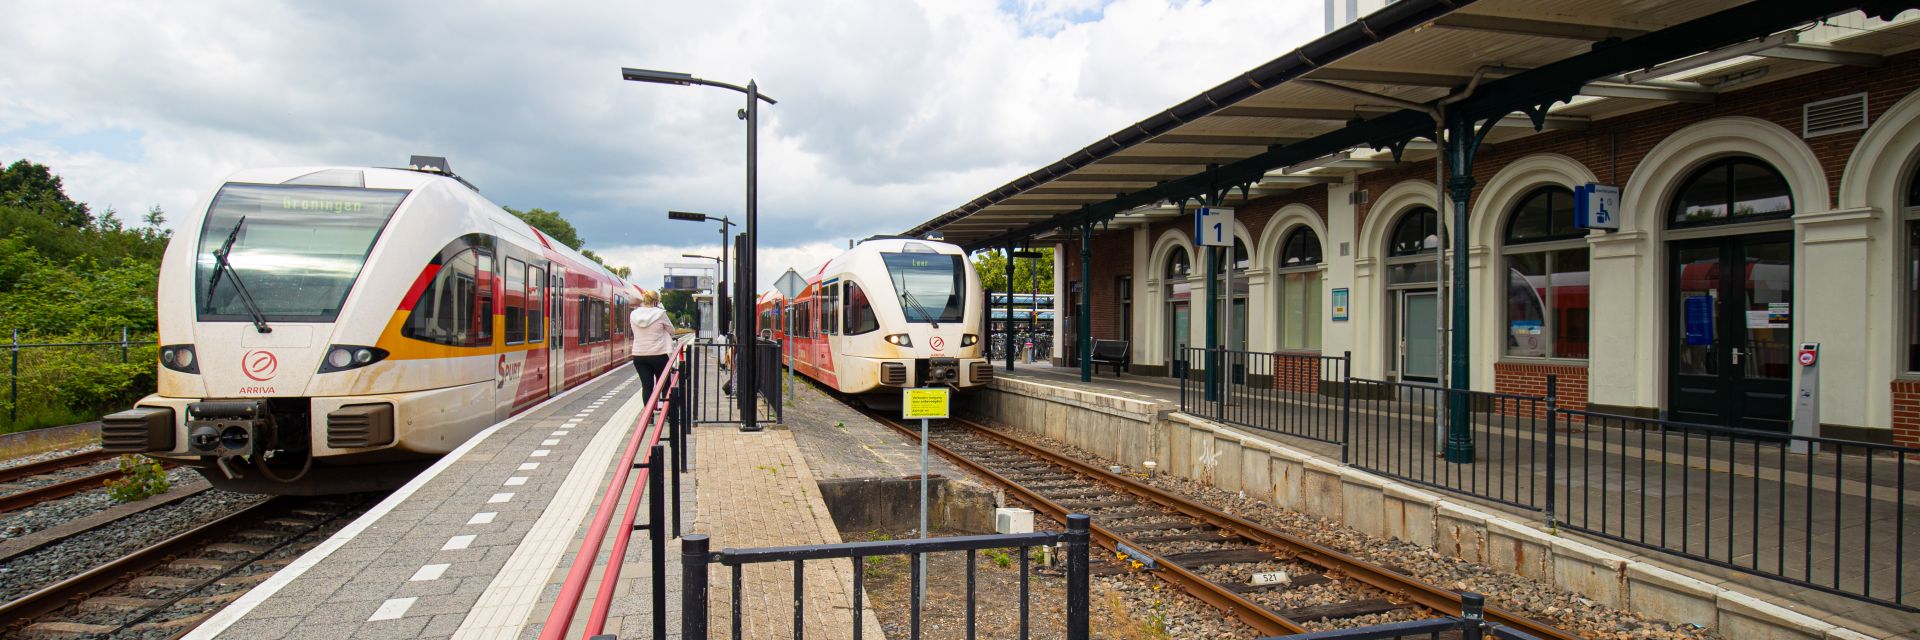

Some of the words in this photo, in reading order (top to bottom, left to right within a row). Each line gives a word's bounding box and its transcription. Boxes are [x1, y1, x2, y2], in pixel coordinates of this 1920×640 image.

[1213, 222, 1222, 242] 1
[911, 258, 929, 267] Leer
[239, 386, 275, 394] ARRIVA
[1263, 573, 1277, 582] 521
